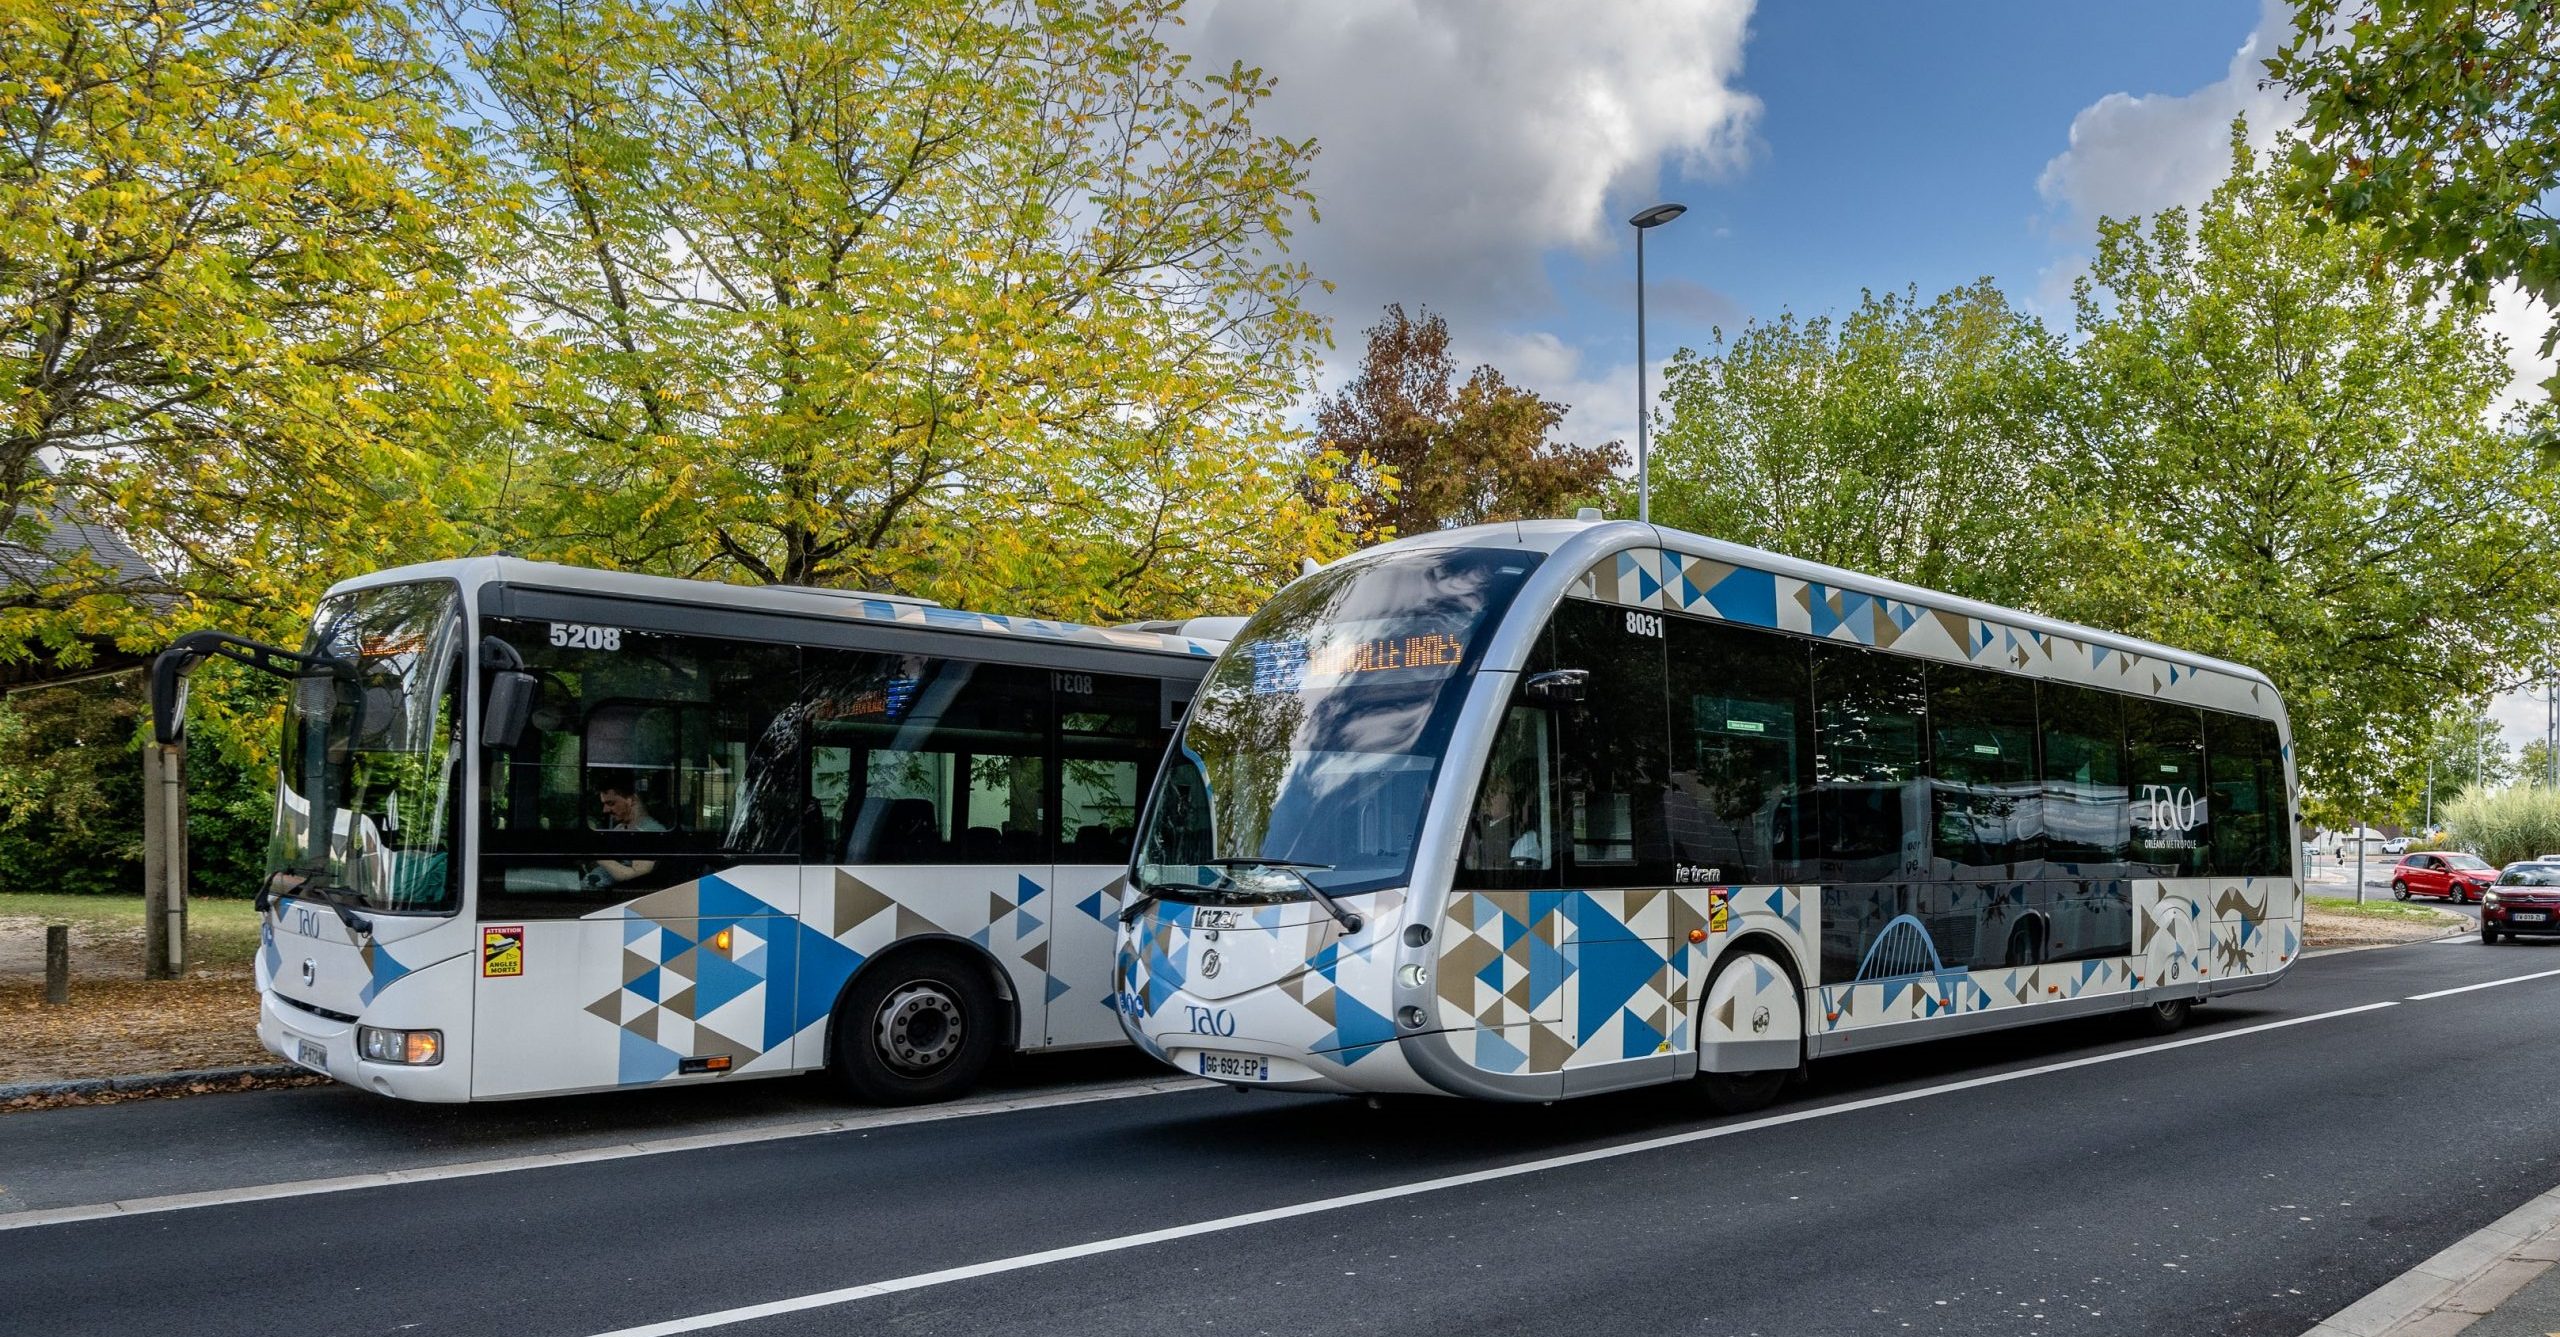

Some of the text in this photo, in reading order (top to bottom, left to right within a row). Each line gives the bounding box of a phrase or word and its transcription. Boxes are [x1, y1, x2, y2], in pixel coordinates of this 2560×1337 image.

[1626, 611, 1663, 638] 8031
[550, 623, 621, 651] 5208
[1691, 864, 1721, 883] tram
[1205, 1056, 1259, 1077] GG-692-EP
